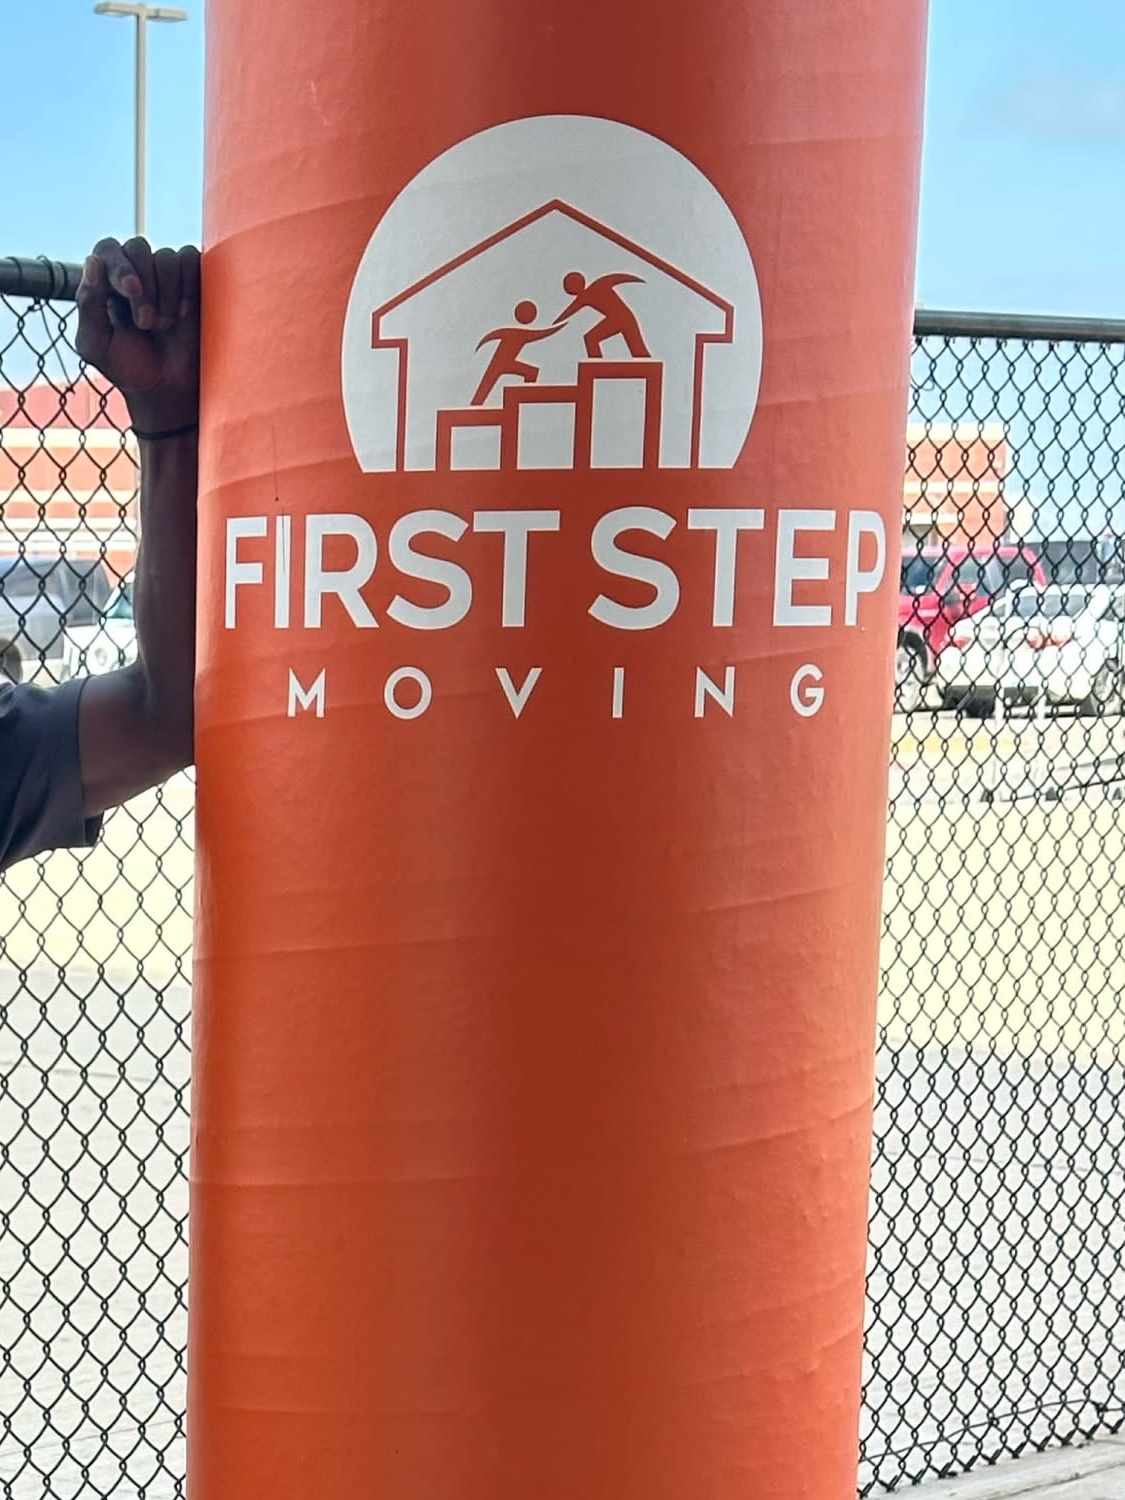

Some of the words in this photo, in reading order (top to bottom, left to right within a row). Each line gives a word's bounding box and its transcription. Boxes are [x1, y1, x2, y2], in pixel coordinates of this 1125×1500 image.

[224, 509, 561, 630] FIRST
[588, 506, 887, 630] STEP
[287, 664, 825, 719] MOVING
